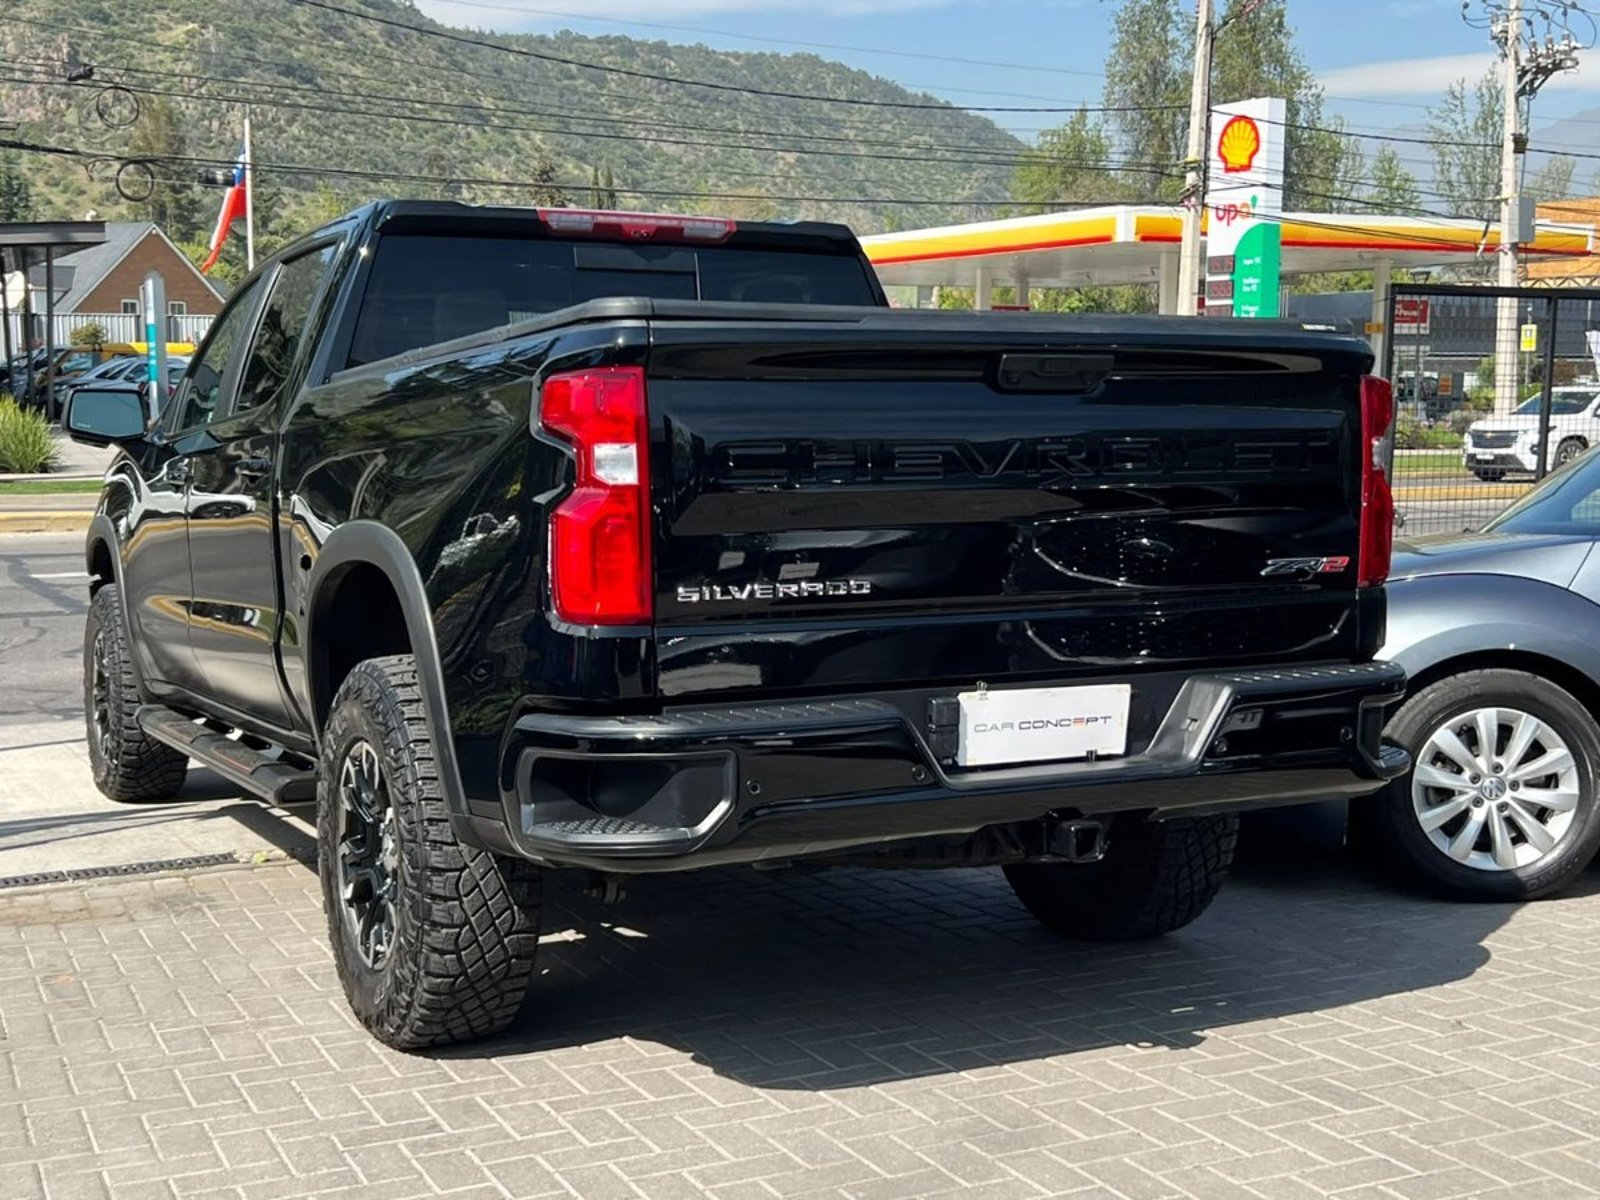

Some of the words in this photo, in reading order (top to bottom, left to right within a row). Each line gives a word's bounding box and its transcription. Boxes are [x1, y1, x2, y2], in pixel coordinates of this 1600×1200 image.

[715, 437, 1330, 483] CHEVROLET
[1260, 556, 1350, 575] ZR2
[676, 578, 872, 603] SILVERADO
[974, 721, 1015, 734] CAR
[1018, 715, 1113, 731] CONCEPT
